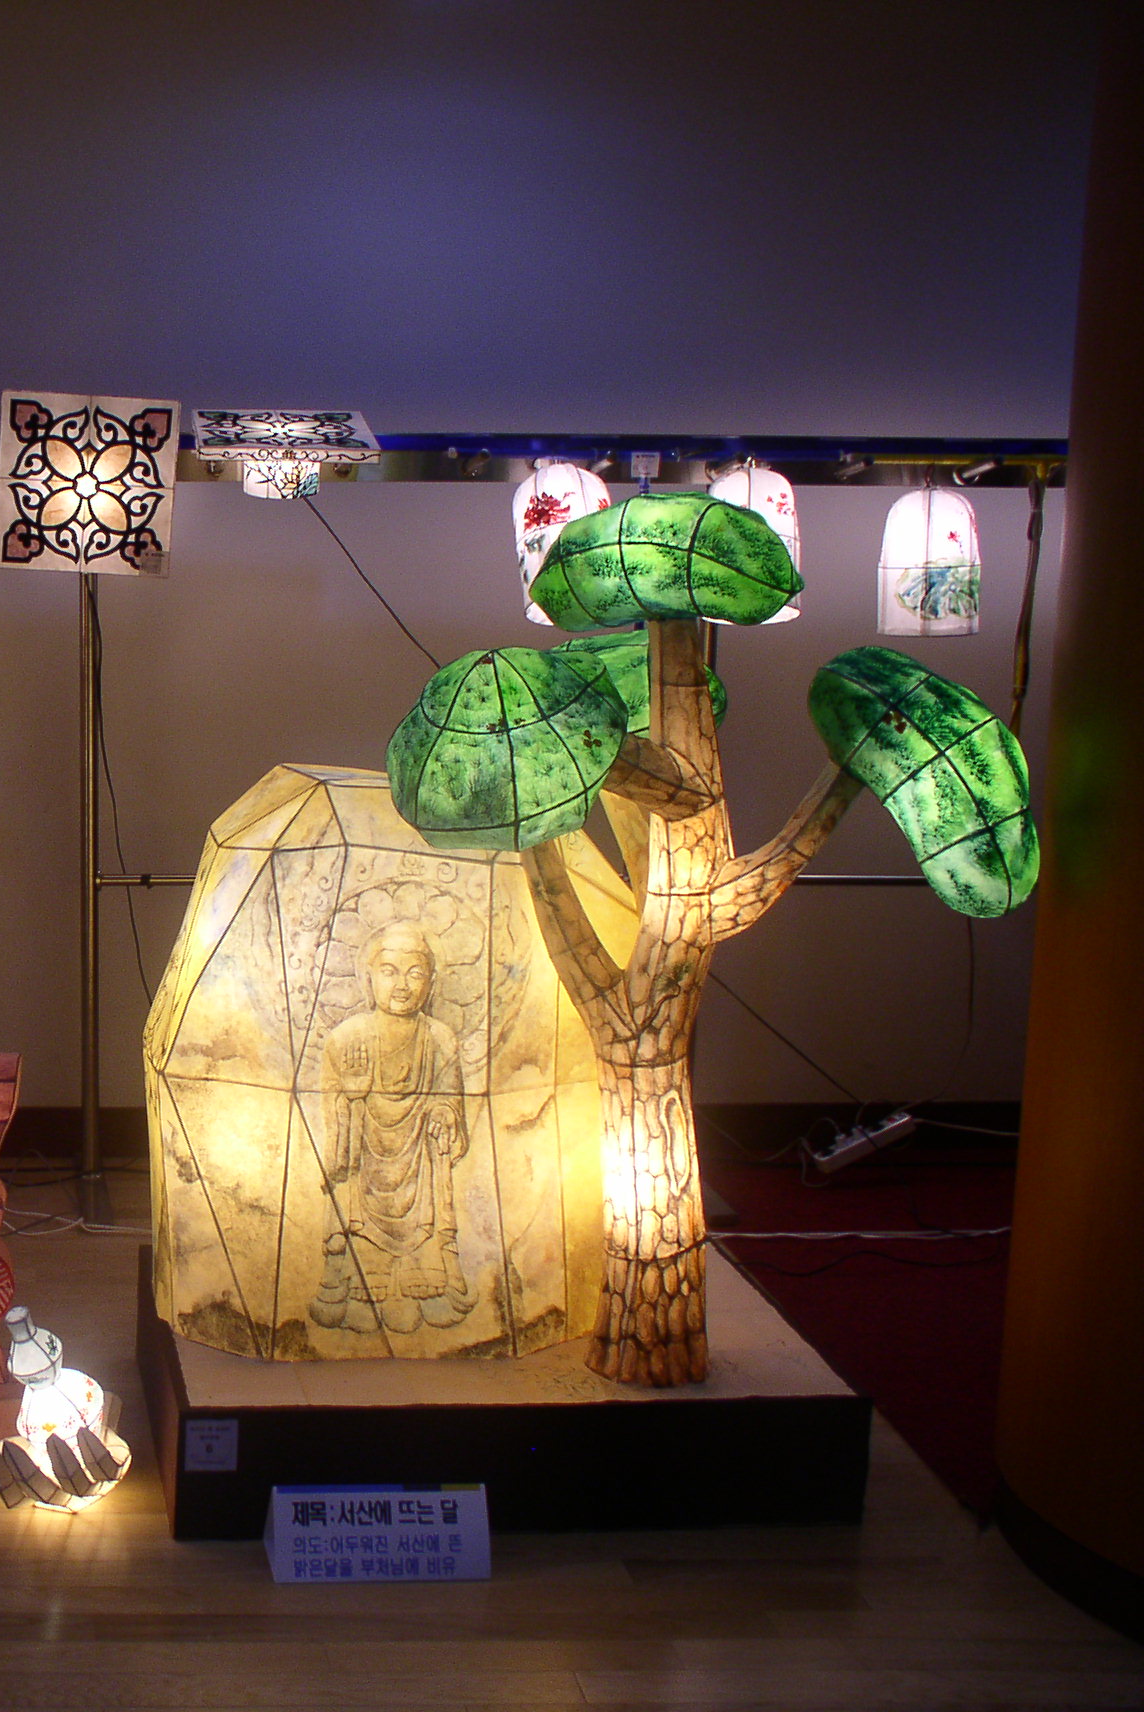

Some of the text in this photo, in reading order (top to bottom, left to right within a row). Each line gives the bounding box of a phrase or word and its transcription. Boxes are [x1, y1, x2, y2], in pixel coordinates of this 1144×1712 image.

[398, 1500, 434, 1525] 뜨는
[440, 1499, 459, 1524] 달
[397, 1534, 440, 1554] 서산에
[426, 1556, 456, 1576] 비유
